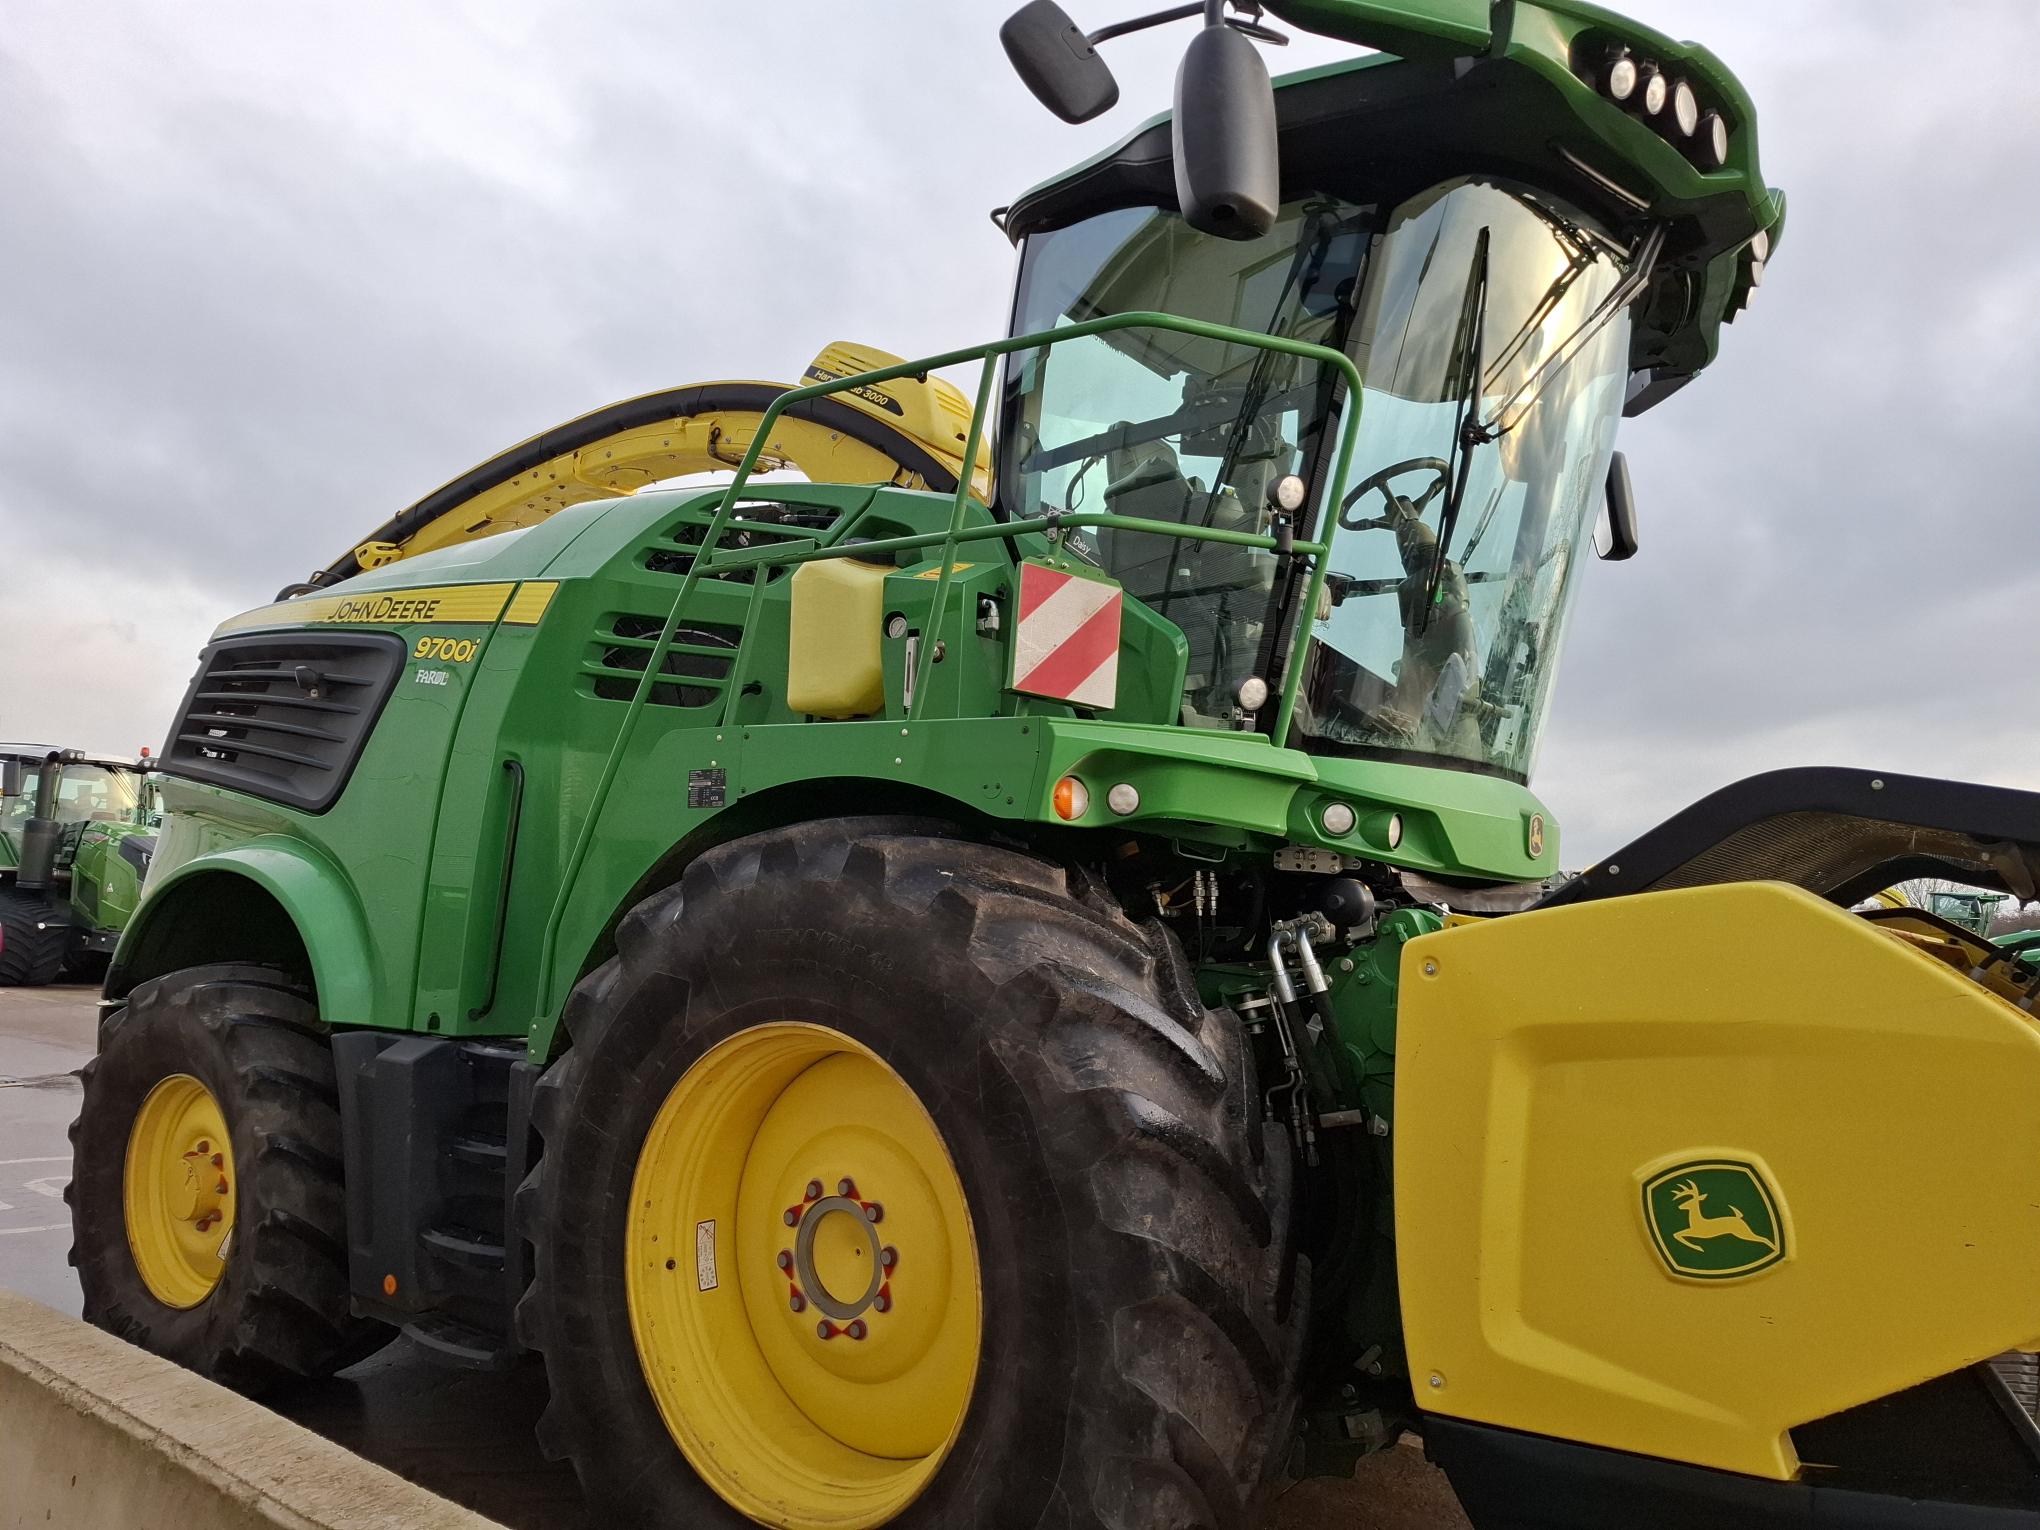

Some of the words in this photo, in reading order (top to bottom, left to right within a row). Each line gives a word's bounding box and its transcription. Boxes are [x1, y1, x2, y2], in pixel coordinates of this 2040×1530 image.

[863, 389, 889, 406] 3000
[1073, 535, 1091, 554] Daisy
[328, 598, 376, 620] JOHN
[373, 596, 441, 619] DEERE
[413, 635, 481, 663] 9700i
[415, 669, 449, 686] FAROL
